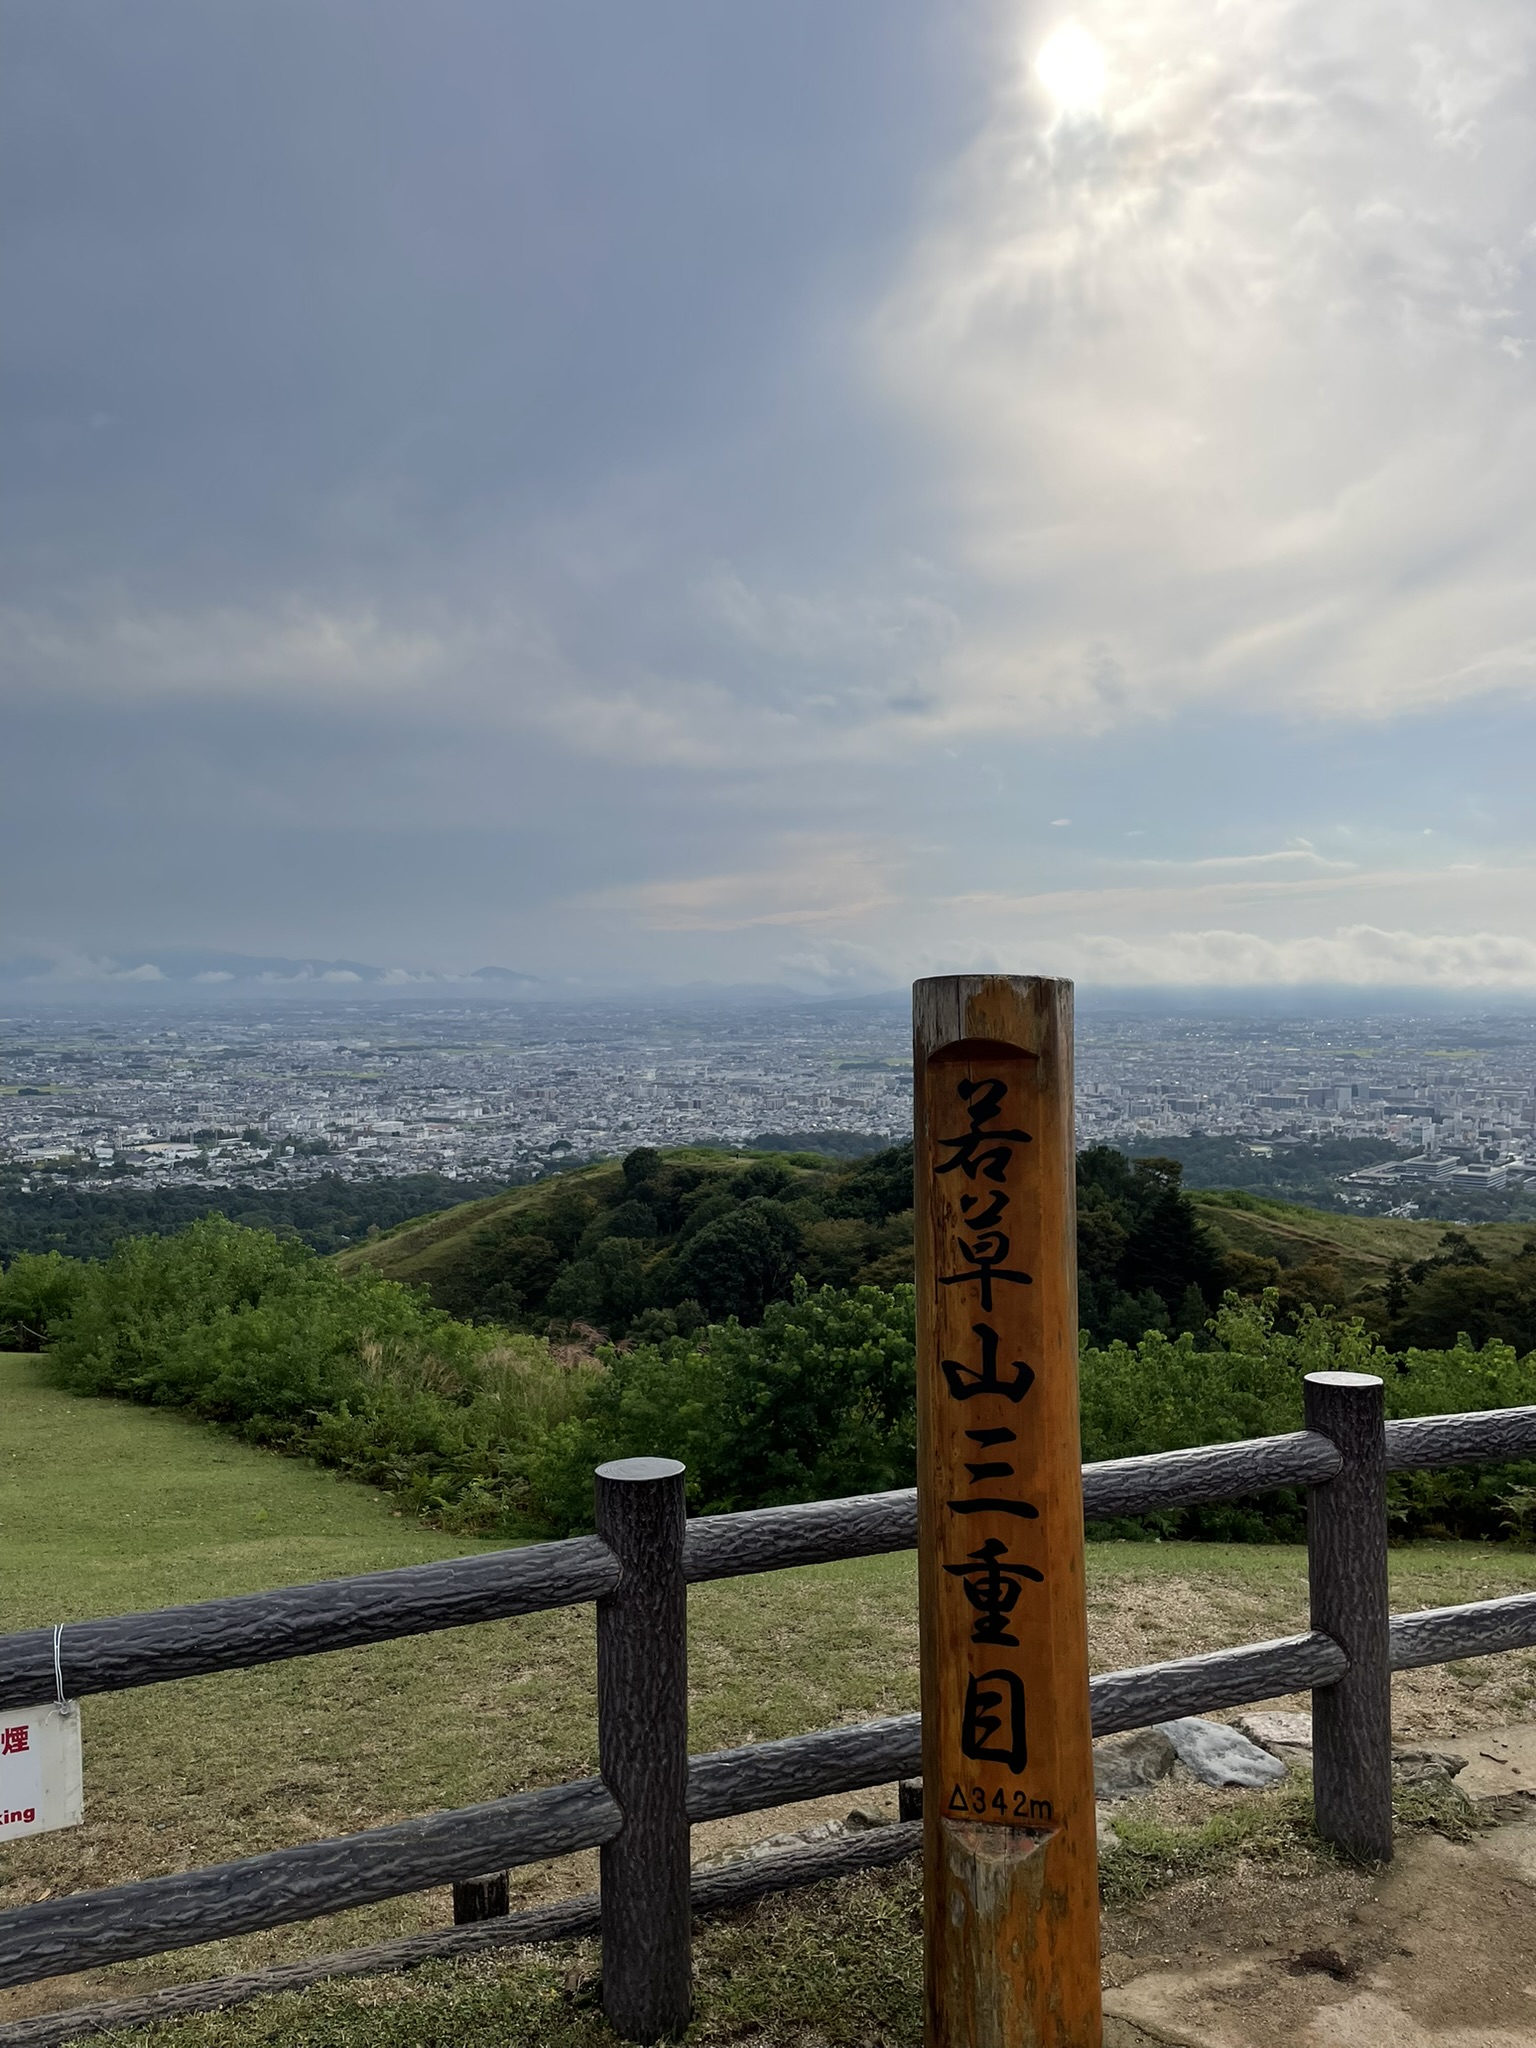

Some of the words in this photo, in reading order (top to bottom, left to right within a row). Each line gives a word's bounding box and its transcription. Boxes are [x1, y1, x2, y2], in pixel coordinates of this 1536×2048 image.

[933, 1078, 1045, 1775] 若草山三重目
